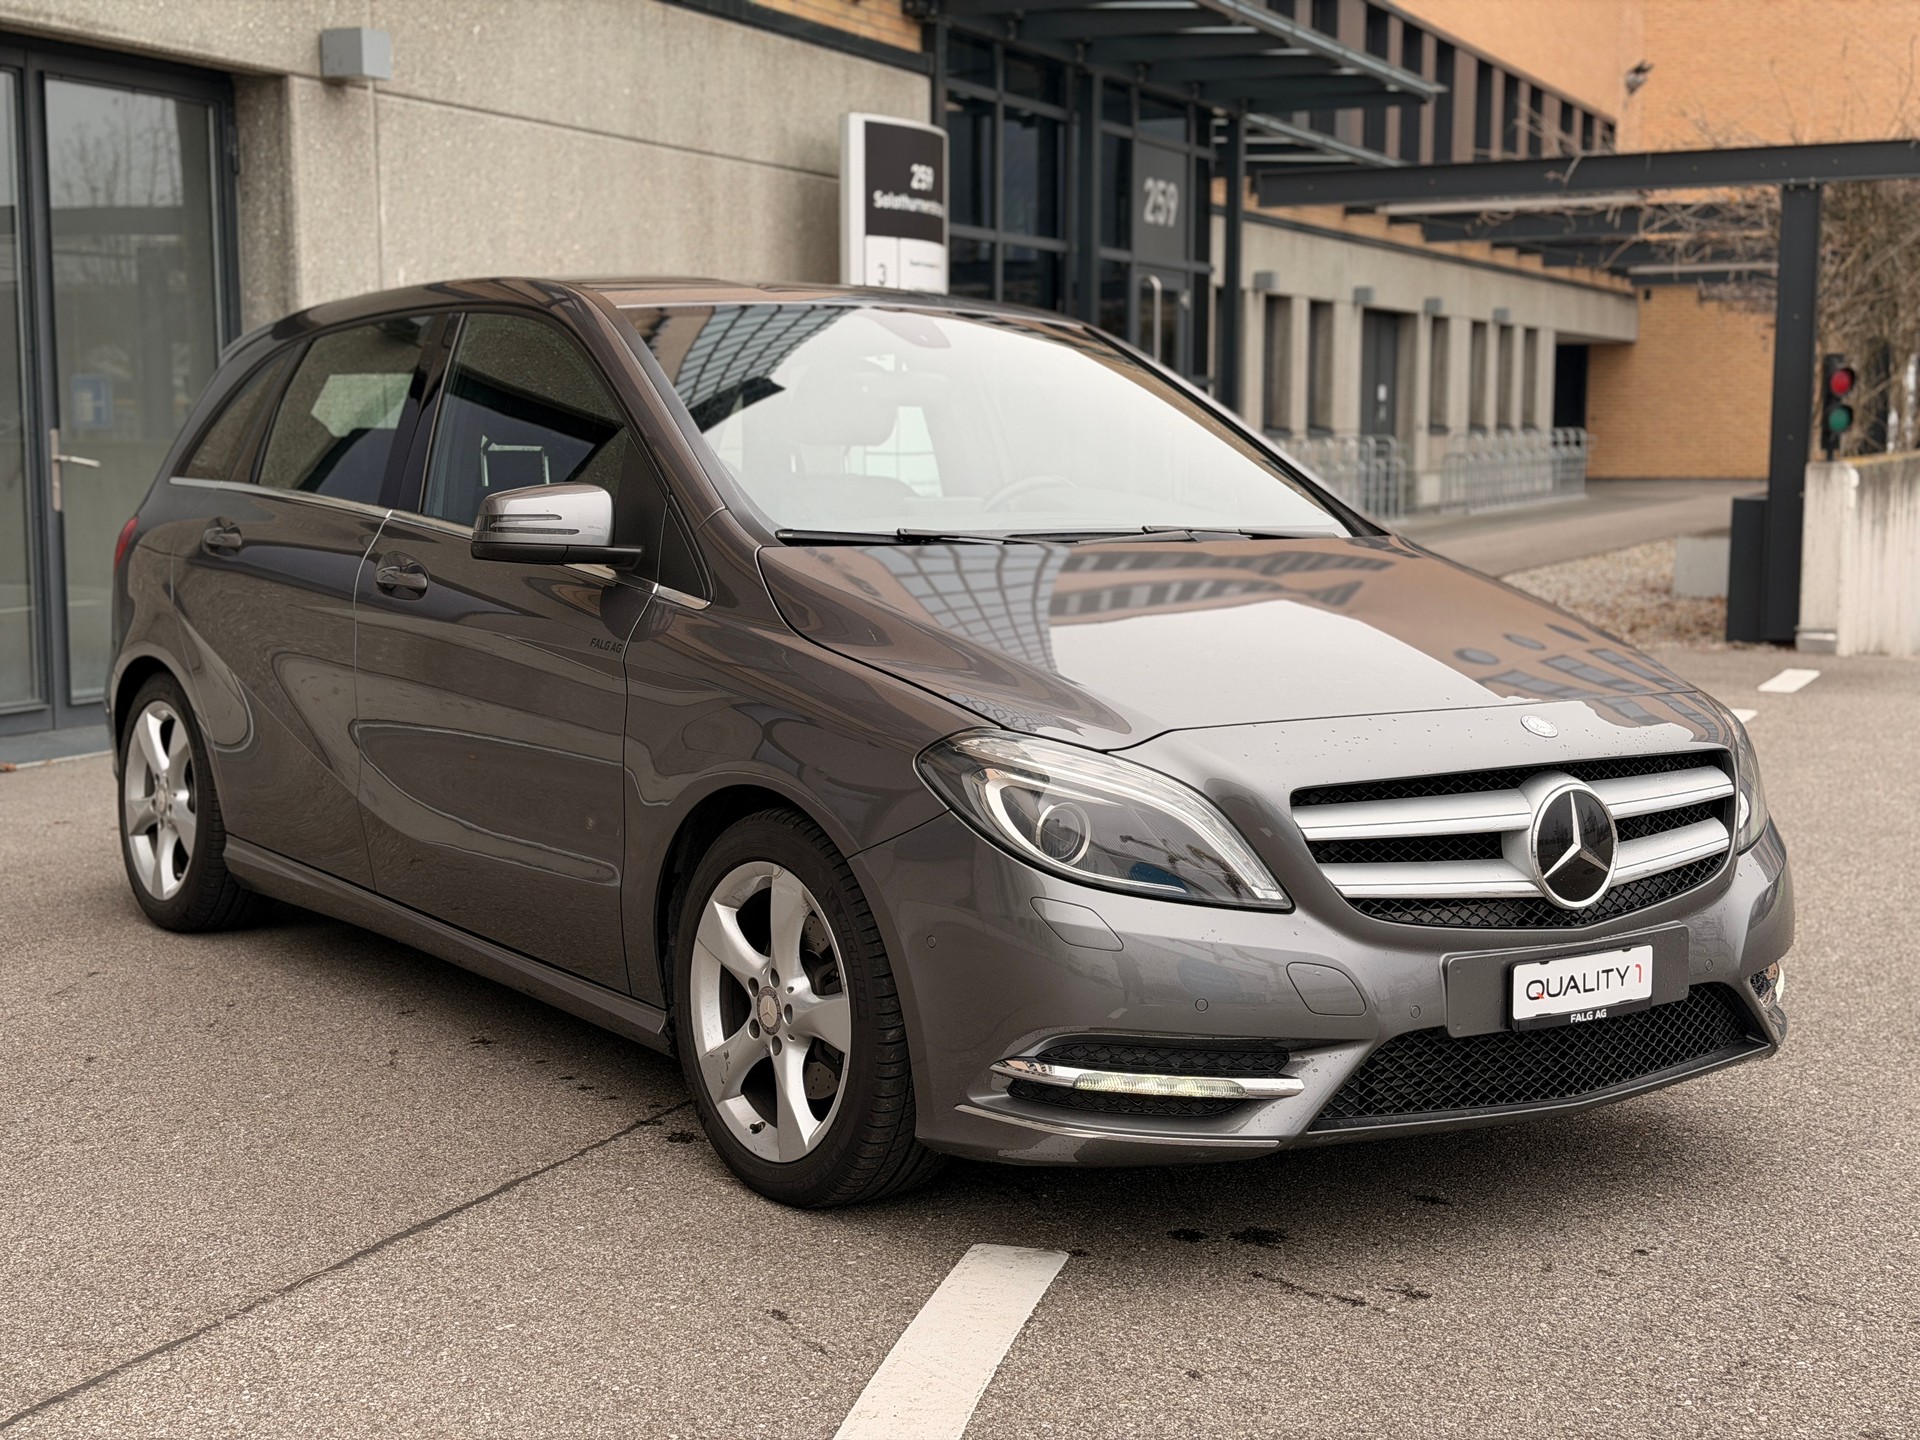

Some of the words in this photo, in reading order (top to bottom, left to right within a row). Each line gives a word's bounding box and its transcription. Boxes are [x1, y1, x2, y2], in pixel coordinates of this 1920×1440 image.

[910, 163, 934, 191] 259
[1143, 177, 1178, 228] 259
[590, 638, 611, 651] FALG
[610, 643, 623, 653] AG
[1525, 965, 1630, 1001] QUALITY
[1635, 963, 1642, 984] 1
[1570, 1011, 1594, 1024] FALG
[1595, 1008, 1608, 1019] AG
